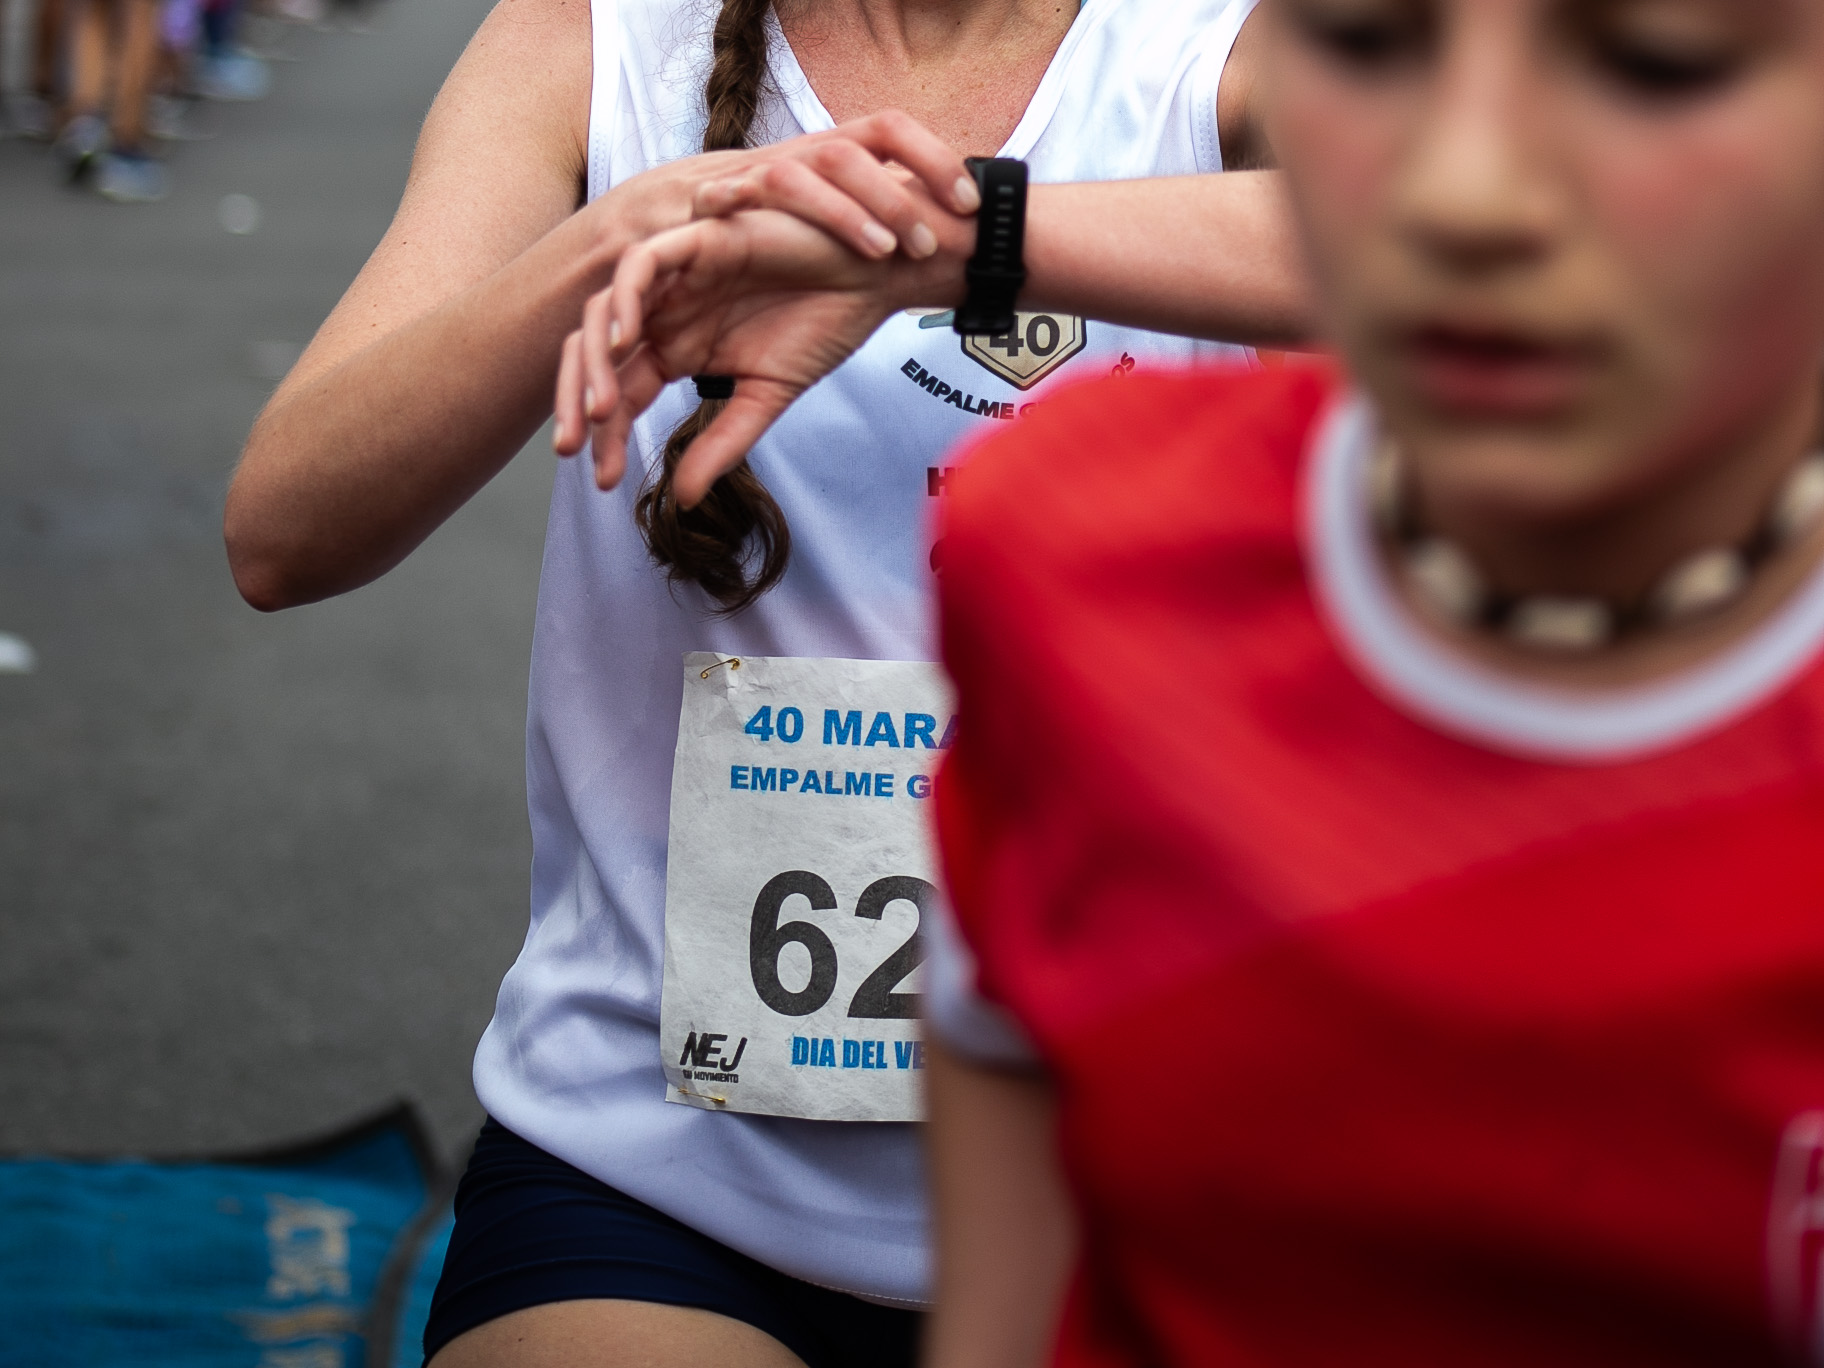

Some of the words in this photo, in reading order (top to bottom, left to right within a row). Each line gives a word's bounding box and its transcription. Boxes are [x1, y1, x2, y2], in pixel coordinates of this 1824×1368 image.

[900, 358, 1015, 420] EMPALME
[744, 705, 805, 743] 40
[730, 765, 895, 798] EMPALME
[906, 774, 940, 800] G
[750, 870, 941, 1019] 62
[679, 1032, 748, 1072] NEJ
[792, 1036, 837, 1068] DIA
[842, 1039, 888, 1069] DEL
[694, 1071, 739, 1084] MOVIMIENTO
